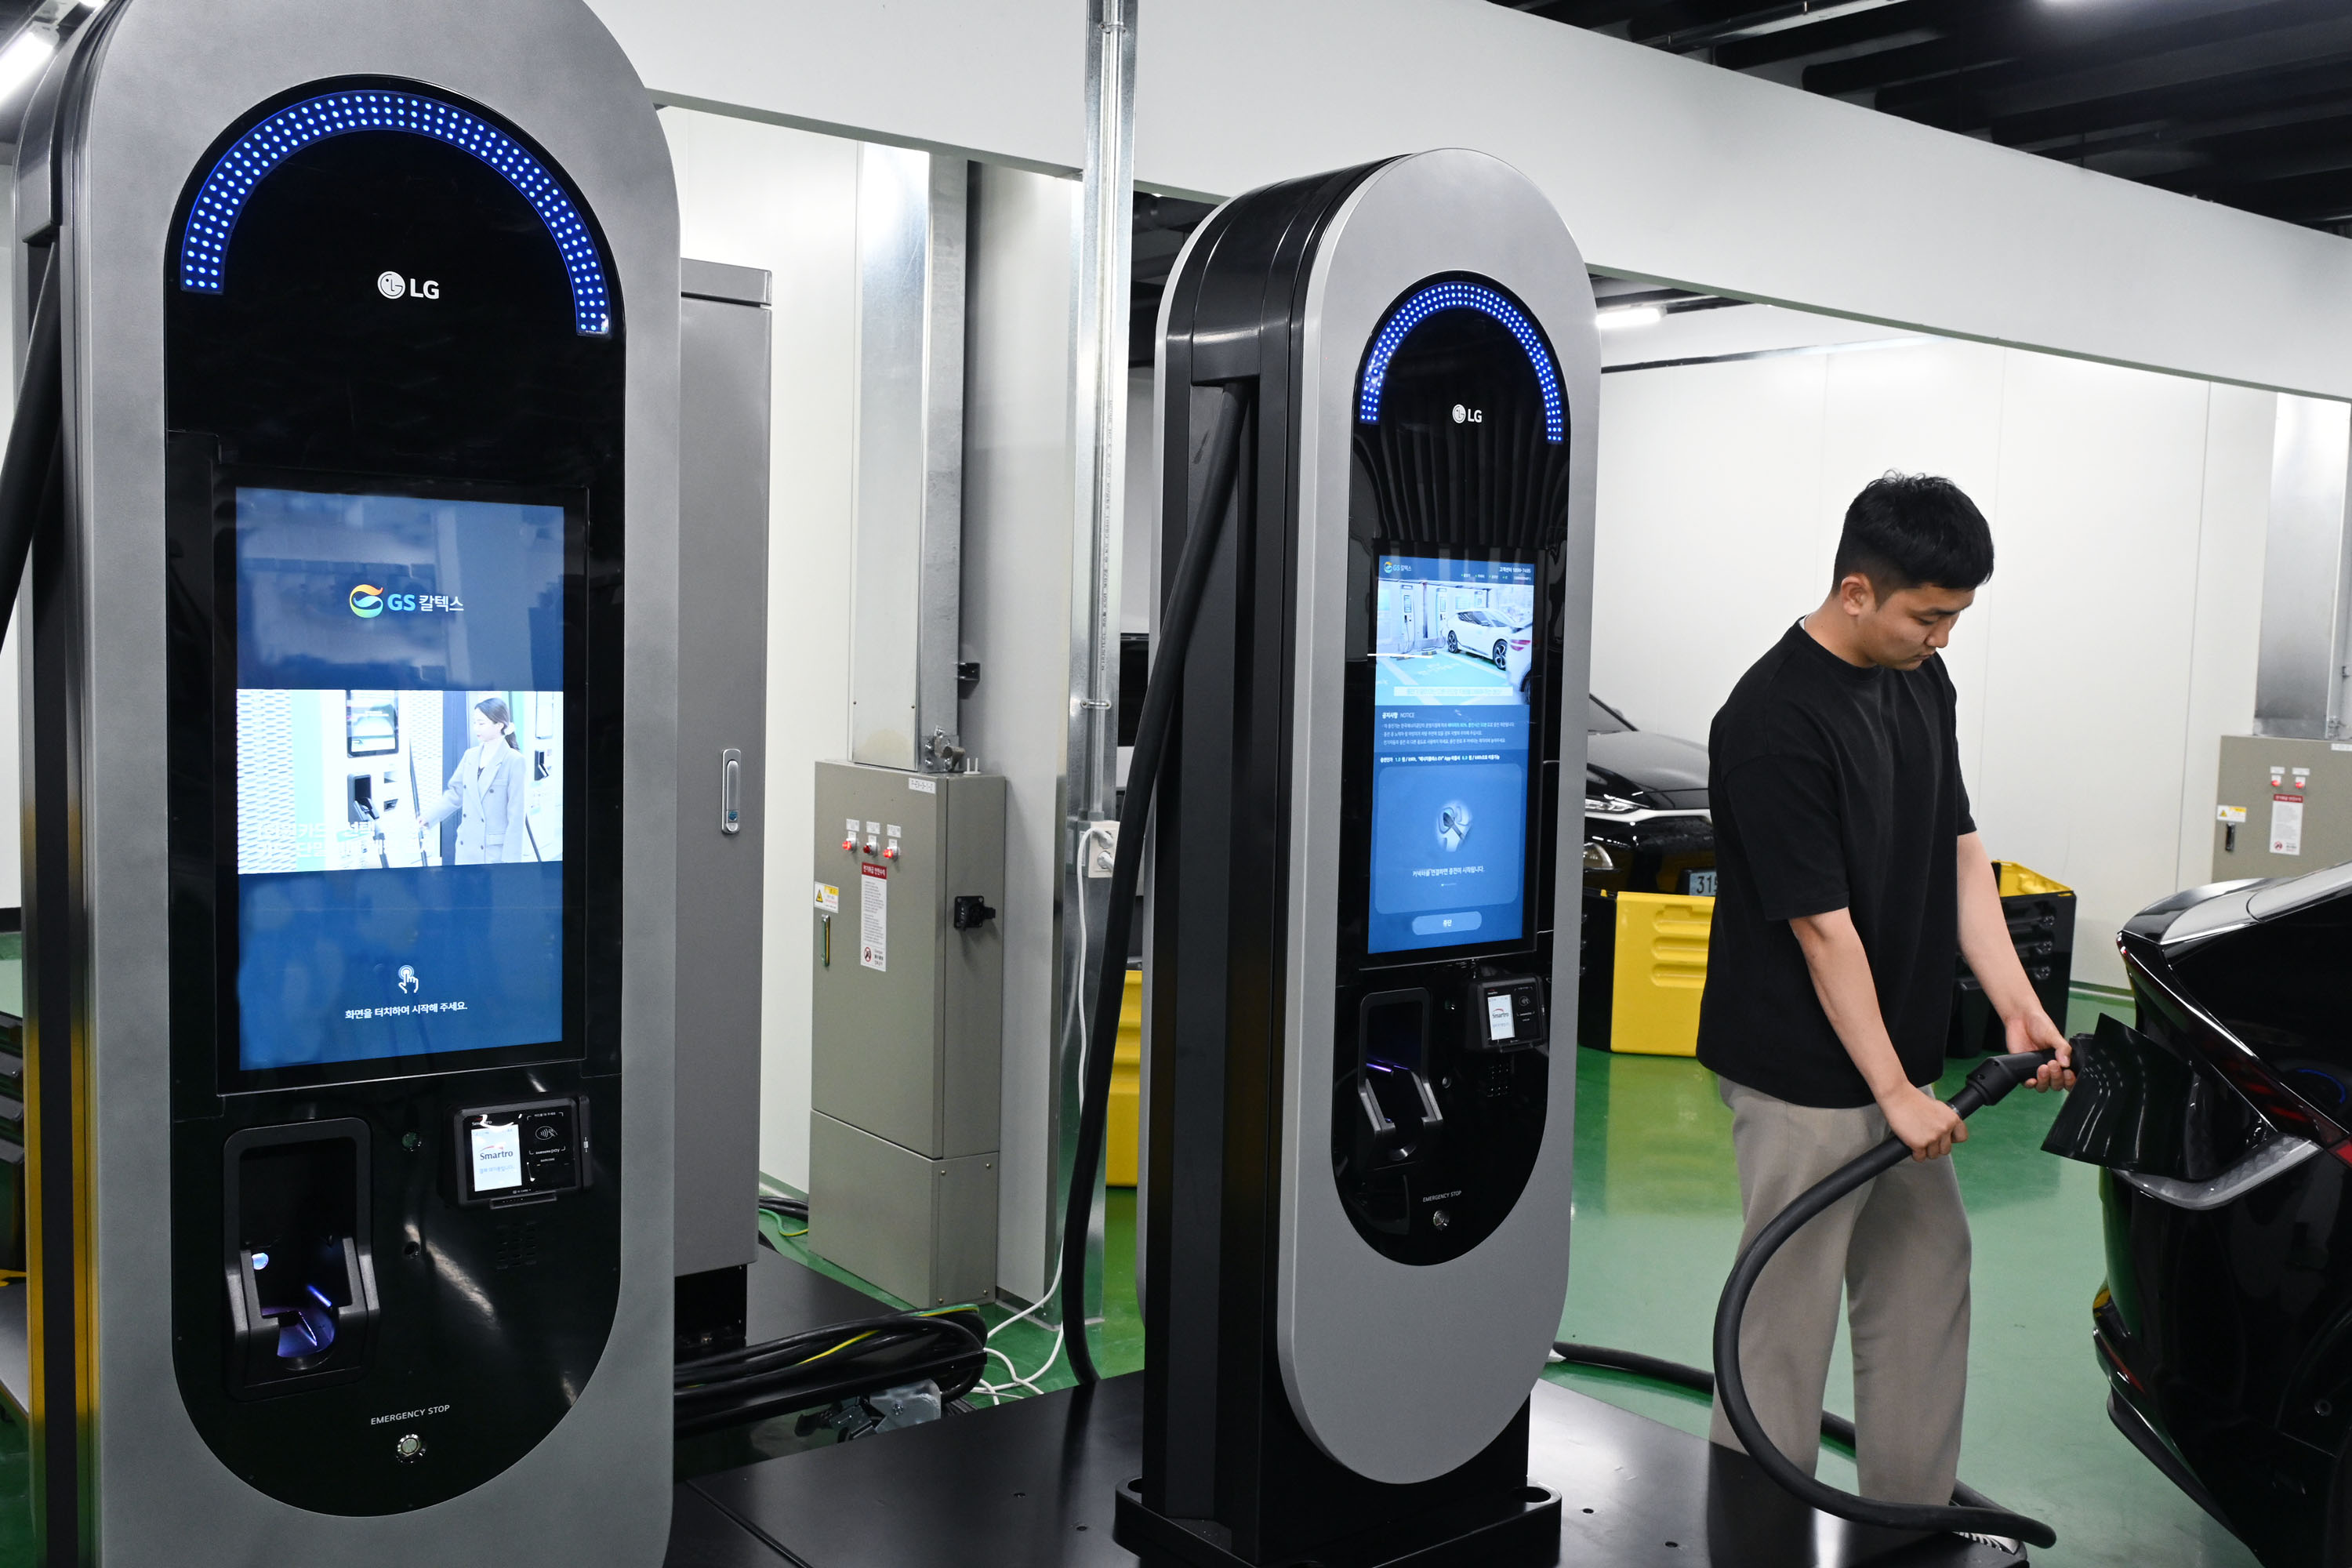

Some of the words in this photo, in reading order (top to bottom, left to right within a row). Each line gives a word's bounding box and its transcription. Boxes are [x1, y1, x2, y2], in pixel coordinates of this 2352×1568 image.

[410, 278, 440, 299] LG
[1468, 408, 1483, 423] LG
[387, 593, 416, 612] GS
[419, 594, 464, 612] 칼텍스
[345, 1009, 372, 1019] 화면을
[374, 1005, 410, 1017] 터치하여
[412, 1003, 438, 1014] 시작해
[439, 1001, 468, 1012] 주세요.
[480, 1149, 514, 1160] Smartro
[1422, 1192, 1450, 1203] EMERGENCY
[370, 1408, 426, 1425] EMERGENCY
[427, 1404, 450, 1415] STOP
